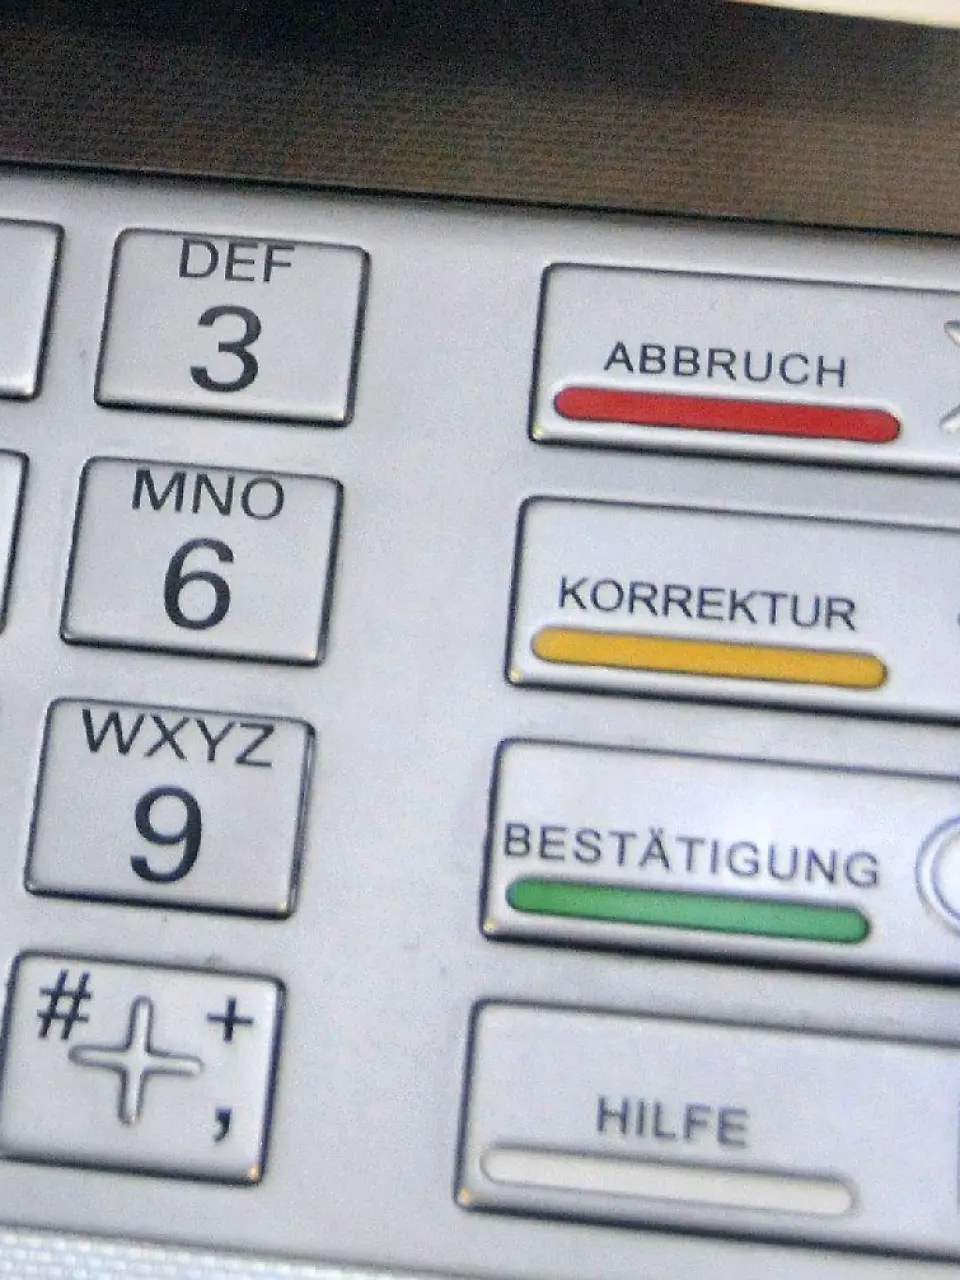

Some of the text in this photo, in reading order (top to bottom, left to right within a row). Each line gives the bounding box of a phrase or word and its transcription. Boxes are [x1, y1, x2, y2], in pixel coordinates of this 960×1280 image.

[179, 237, 296, 283] DEF
[190, 305, 262, 393] 3
[603, 341, 847, 388] ABBRUCH
[131, 469, 285, 521] MNO
[163, 537, 235, 631] 6
[557, 576, 859, 631] KORREKTUR
[81, 707, 275, 769] WXYZ
[130, 785, 203, 884] 9
[503, 821, 882, 889] BESTÄTIGUNG
[596, 1094, 750, 1150] HILFE
